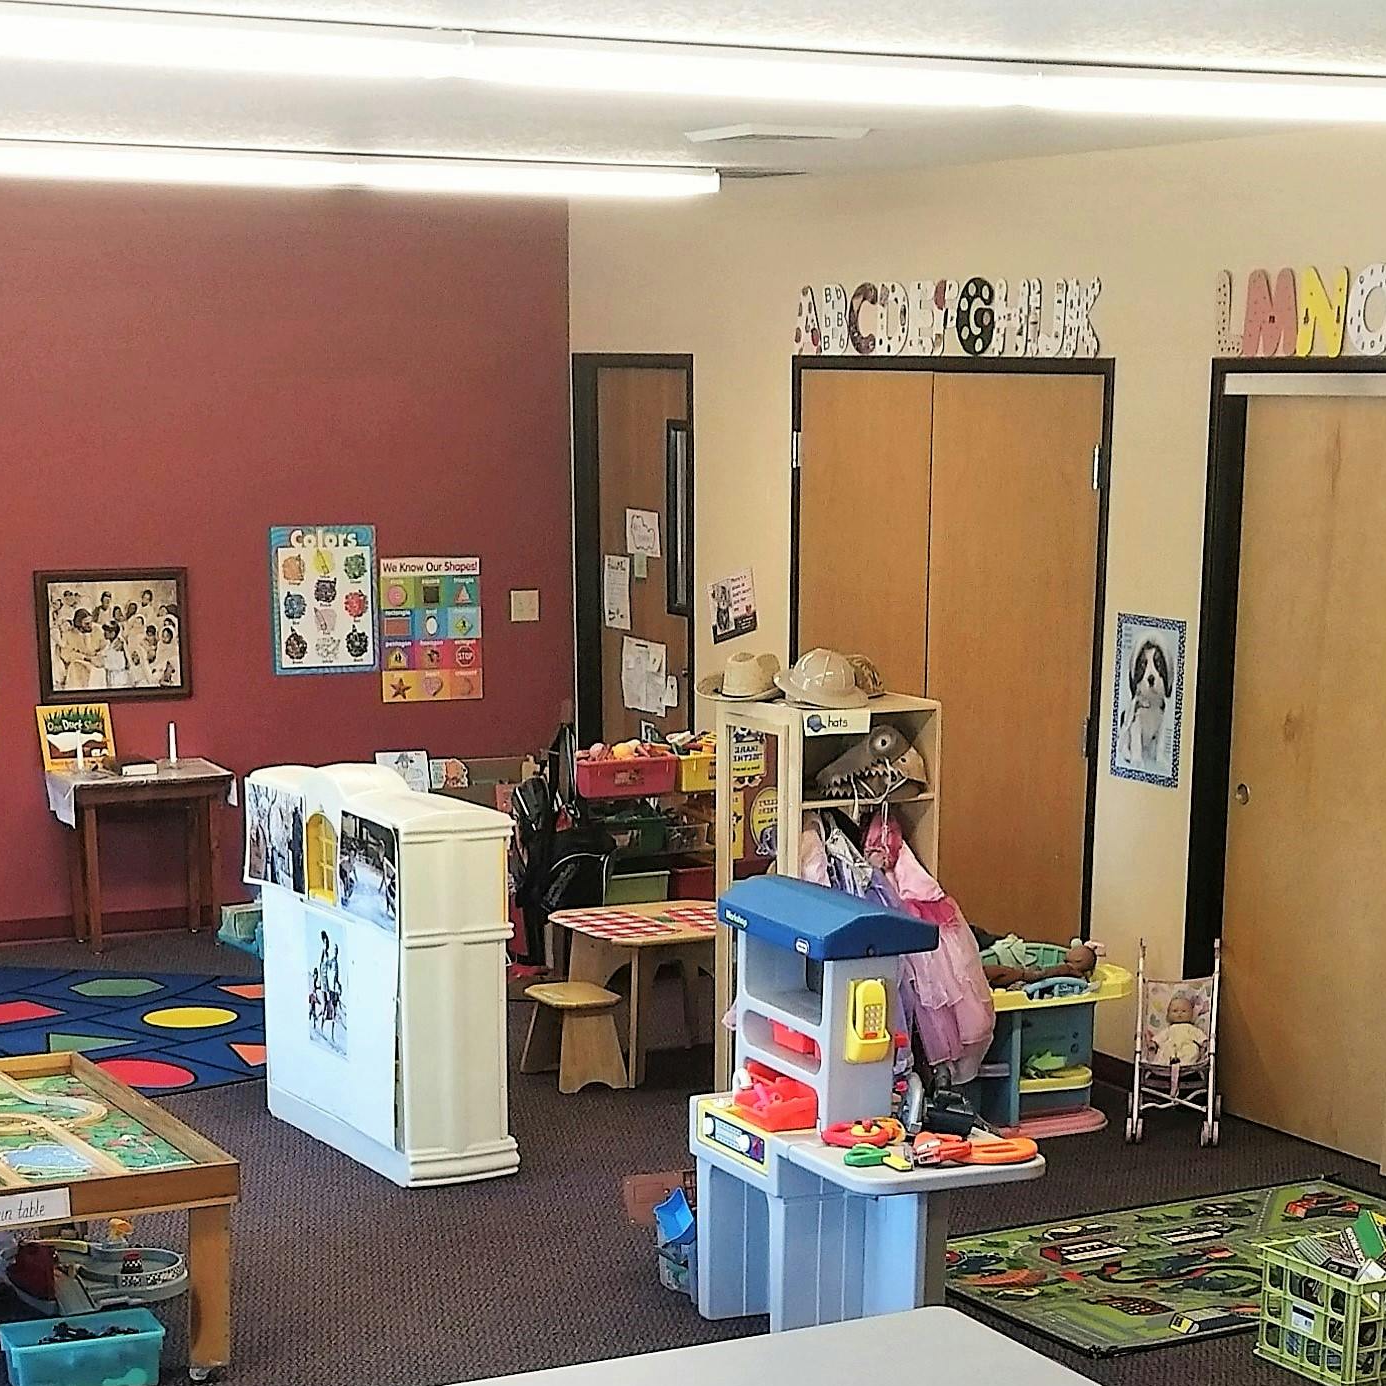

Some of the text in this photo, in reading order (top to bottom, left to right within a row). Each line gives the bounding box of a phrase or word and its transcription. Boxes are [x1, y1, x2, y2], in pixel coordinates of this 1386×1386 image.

[290, 529, 358, 548] Colors
[383, 561, 478, 573] We Know Our Shapes!
[458, 652, 473, 660] STOP
[827, 714, 848, 728] hats
[18, 1197, 45, 1219] table
